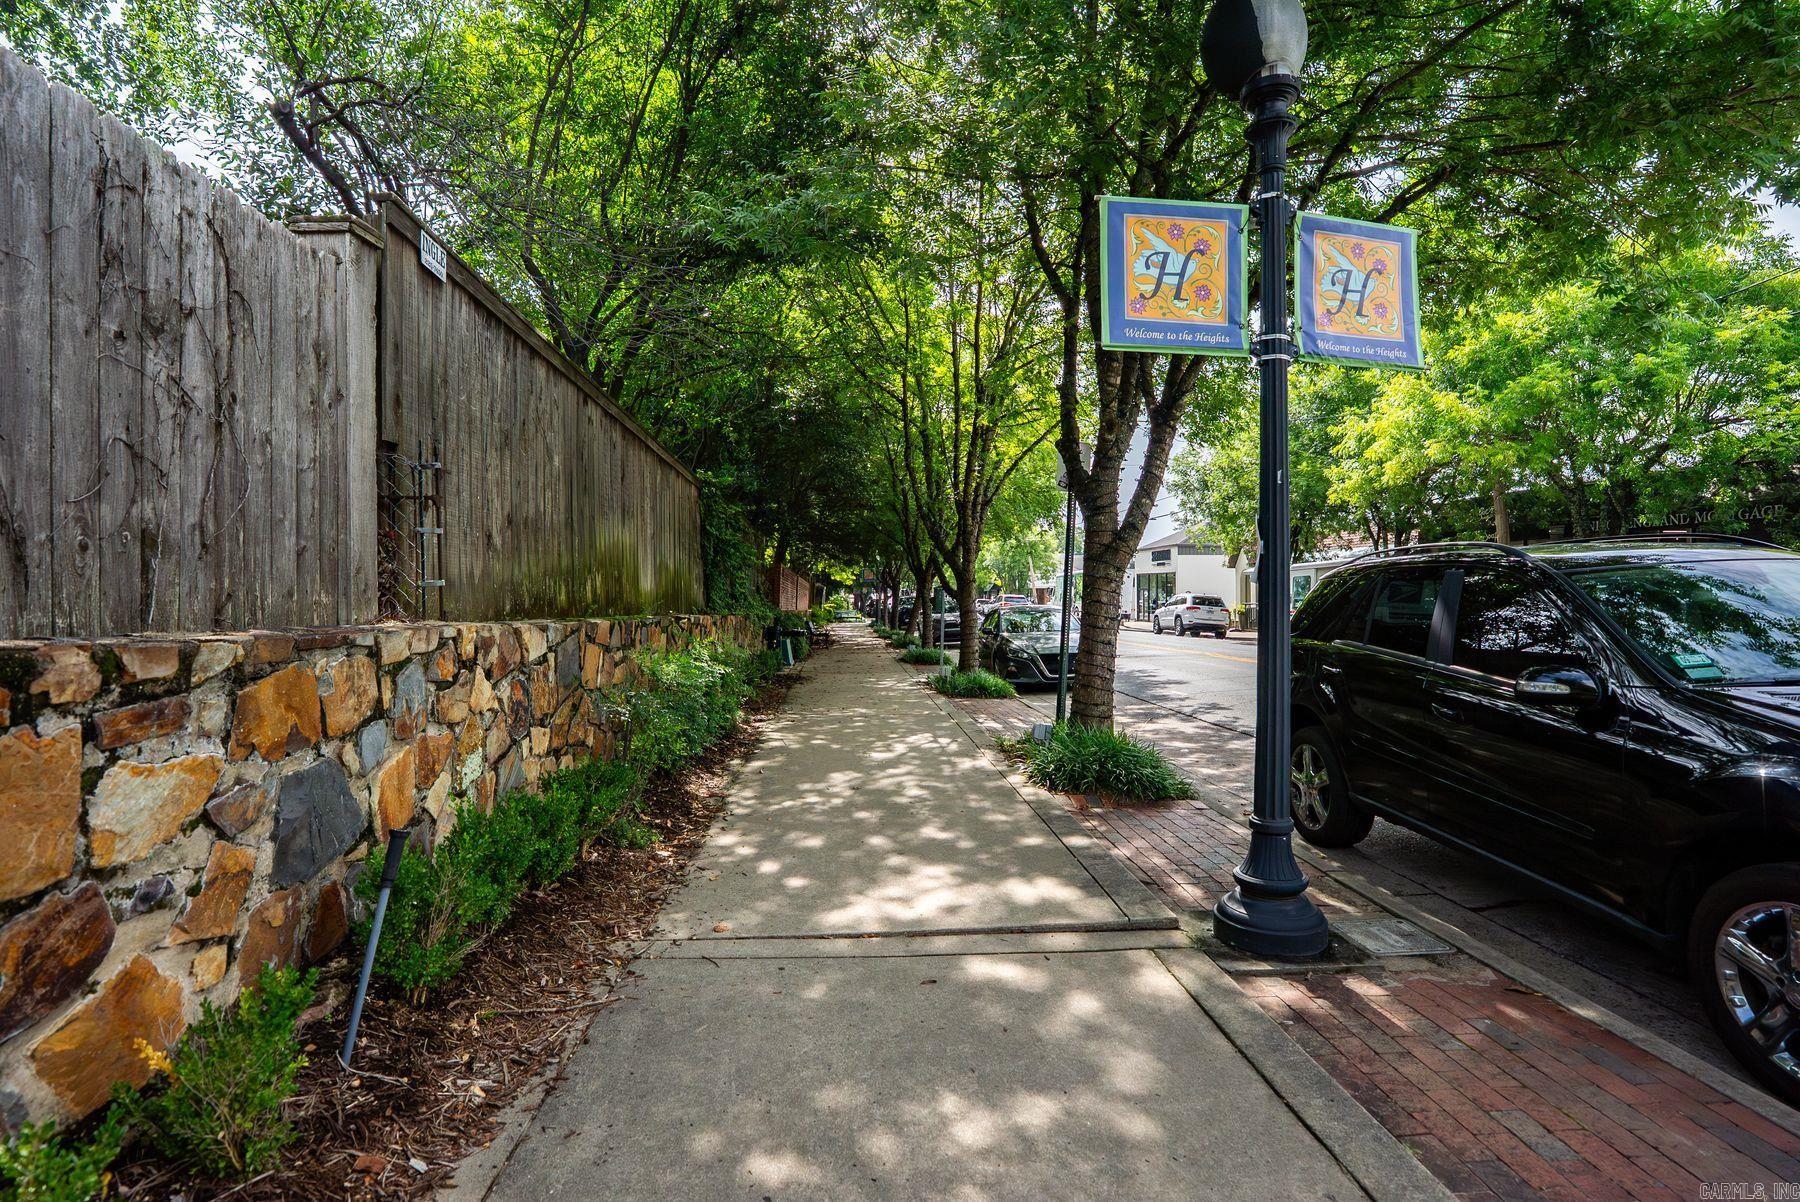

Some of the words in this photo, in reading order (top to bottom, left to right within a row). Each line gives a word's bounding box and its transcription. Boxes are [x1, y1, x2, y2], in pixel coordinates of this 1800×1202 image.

[422, 233, 446, 269] INGLE
[1139, 249, 1206, 301] H
[1326, 268, 1383, 317] H
[1124, 327, 1164, 340] Welcome
[1167, 331, 1177, 340] to
[1179, 330, 1193, 341] the
[1194, 332, 1230, 345] Heights
[1316, 339, 1350, 352] Welcome
[1352, 345, 1361, 353] to
[1362, 344, 1375, 355] the
[1375, 347, 1407, 359] Heights
[1628, 513, 1690, 529] NGAND
[1694, 504, 1784, 524] MOGAGE
